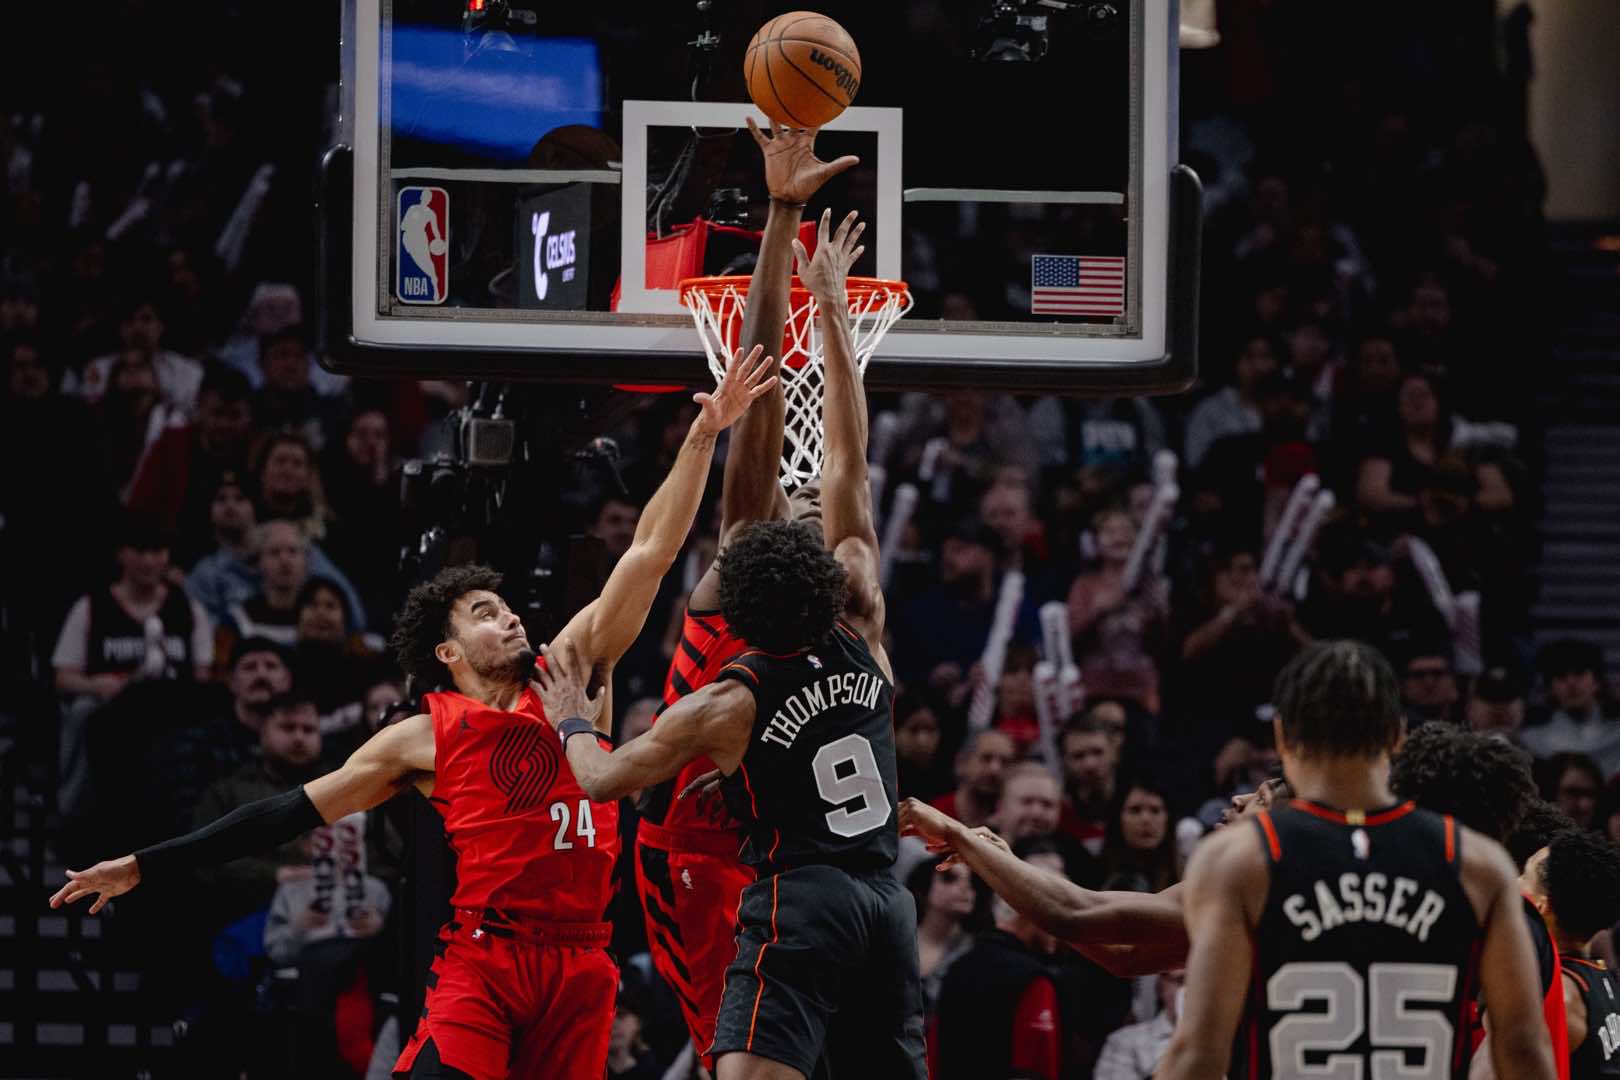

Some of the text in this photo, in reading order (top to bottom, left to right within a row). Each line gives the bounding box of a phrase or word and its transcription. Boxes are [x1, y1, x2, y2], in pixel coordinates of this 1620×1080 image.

[546, 230, 576, 269] CELSIUS
[404, 276, 428, 296] NBA
[761, 672, 884, 749] THOMPSON
[812, 733, 892, 838] 9
[549, 799, 597, 851] 24
[1282, 872, 1445, 942] SASSER
[1266, 961, 1458, 1080] 25
